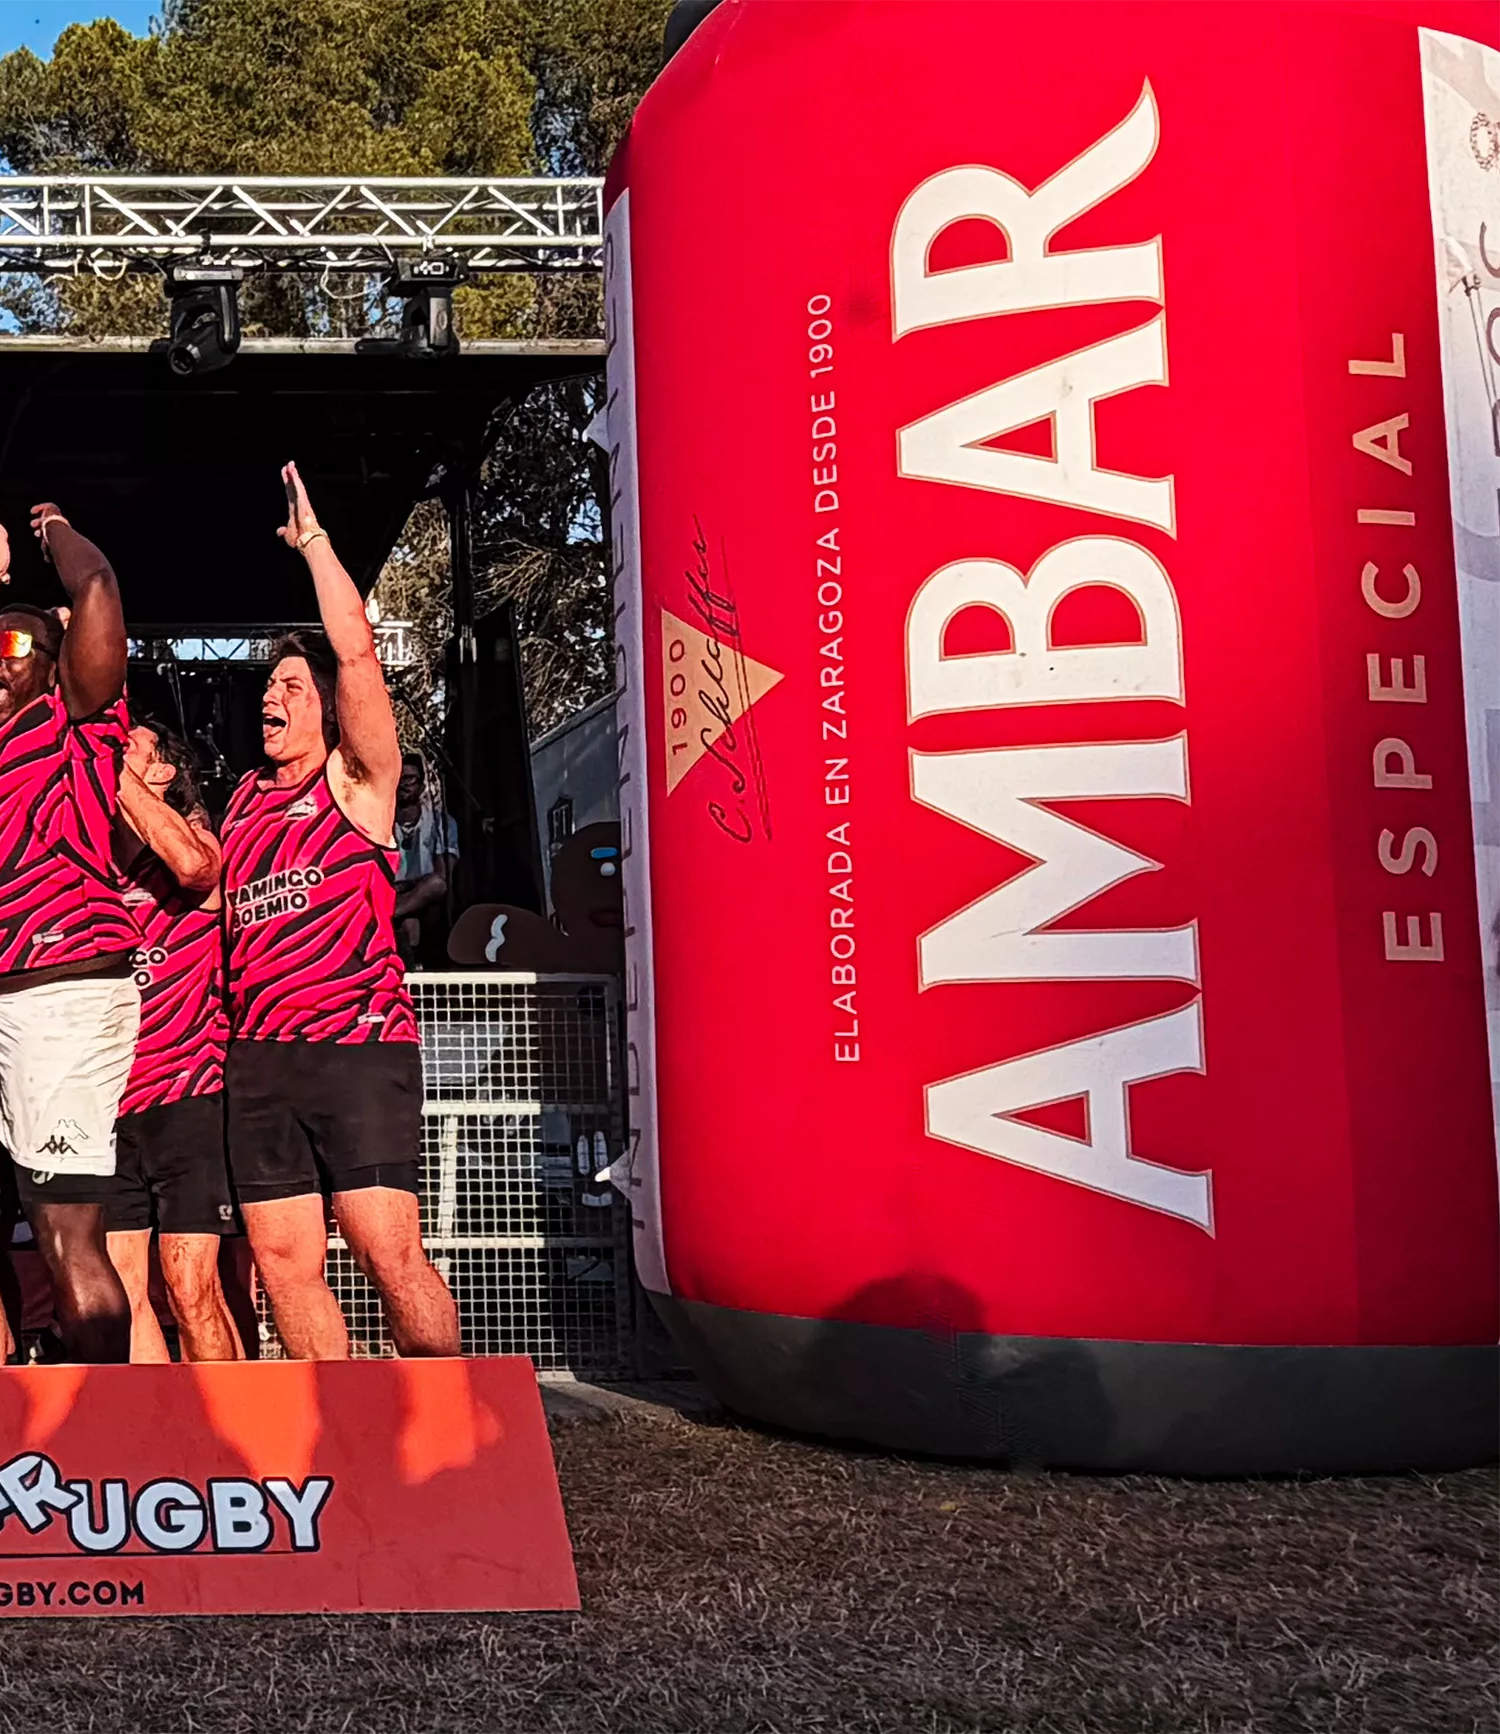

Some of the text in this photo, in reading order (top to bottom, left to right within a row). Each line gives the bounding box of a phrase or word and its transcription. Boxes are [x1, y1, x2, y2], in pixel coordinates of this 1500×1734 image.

[235, 866, 324, 907] AMINGO
[668, 637, 689, 757] 1900
[806, 293, 861, 1063] ELABORADA EN ZARAGOZA DESDE 1900
[891, 75, 1216, 1238] AMBAR
[1348, 332, 1445, 963] ESPECIAL
